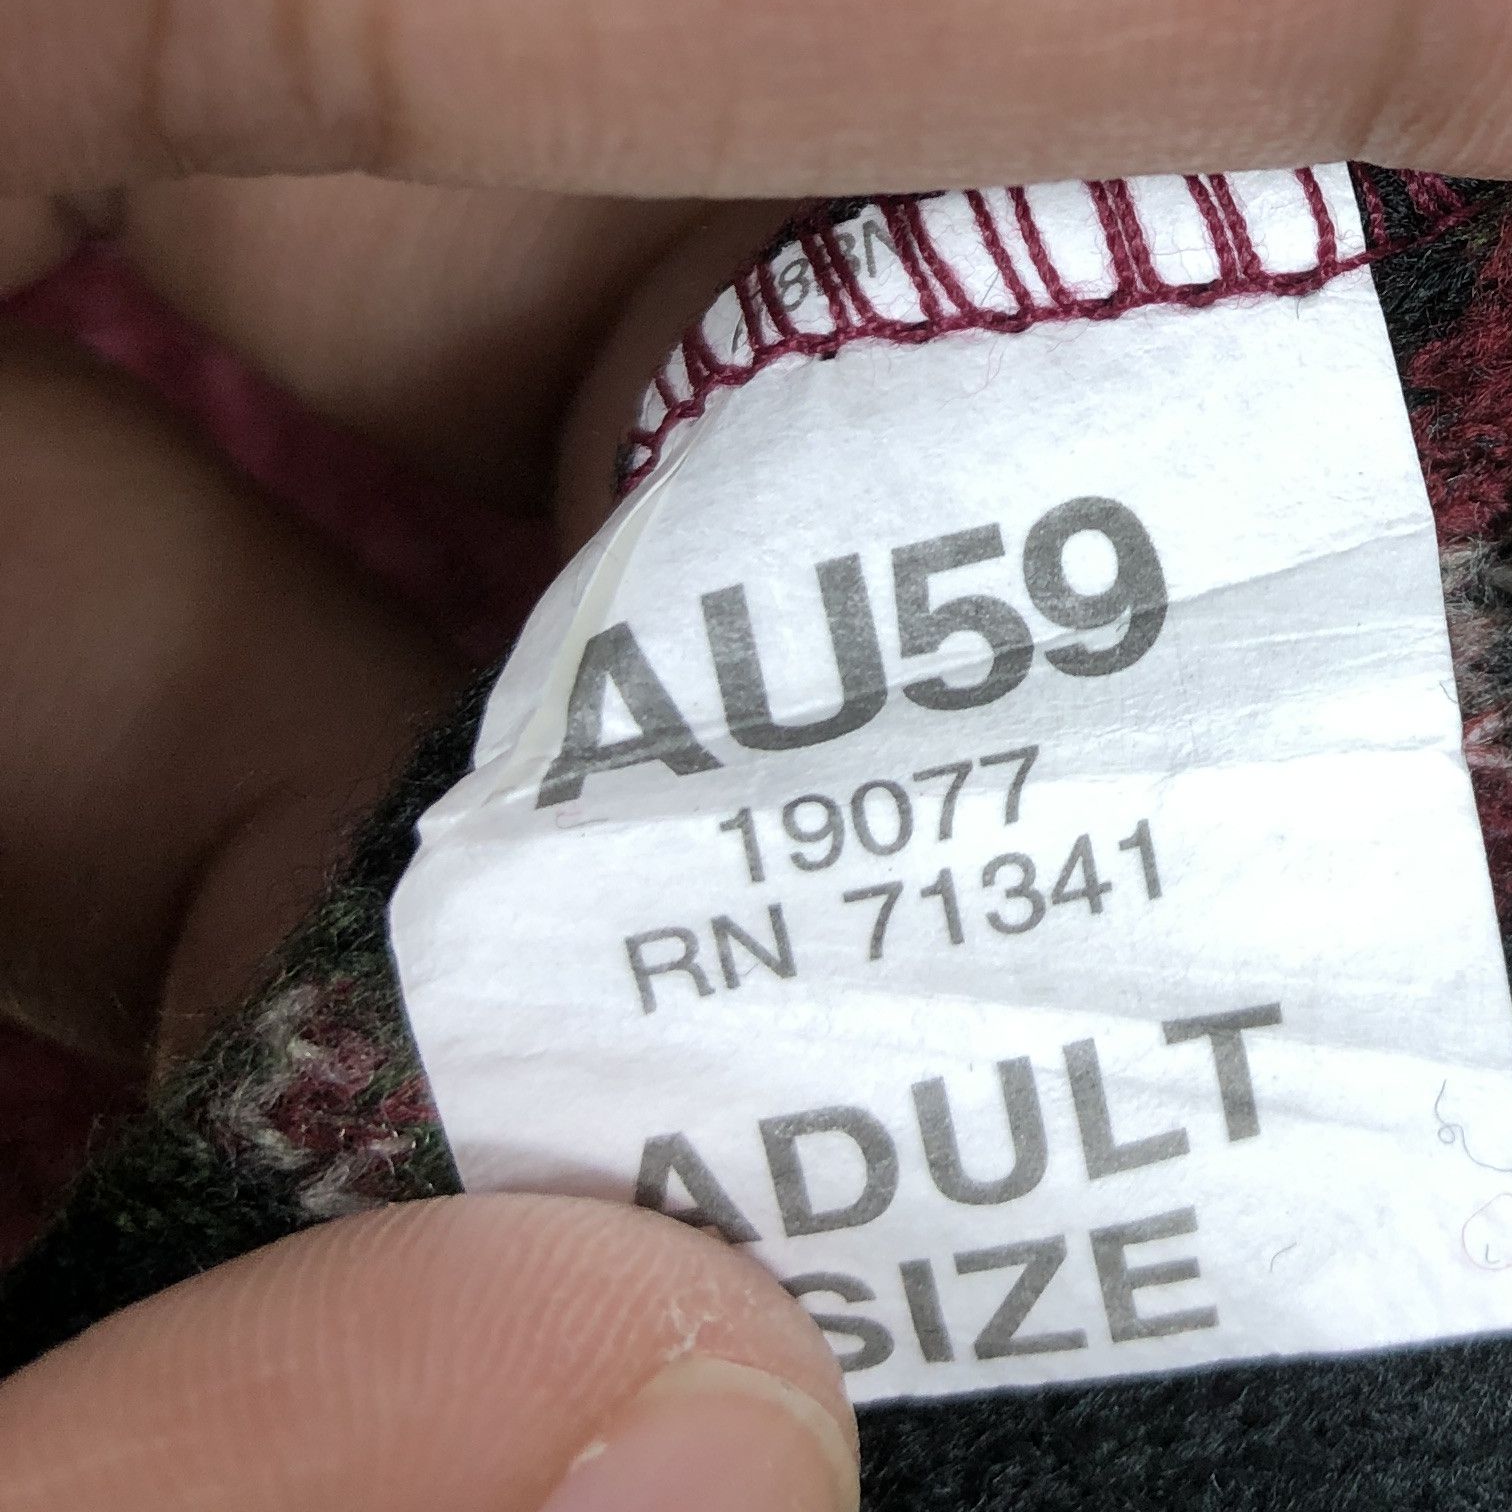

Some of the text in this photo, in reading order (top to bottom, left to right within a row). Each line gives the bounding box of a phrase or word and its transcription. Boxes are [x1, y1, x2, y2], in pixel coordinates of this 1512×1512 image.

[535, 494, 1169, 810] AU59
[719, 744, 1040, 884] 19077
[624, 818, 1163, 1014] RN 71341
[633, 1001, 1285, 1245] ADULT
[778, 1205, 1221, 1374] SIZE
